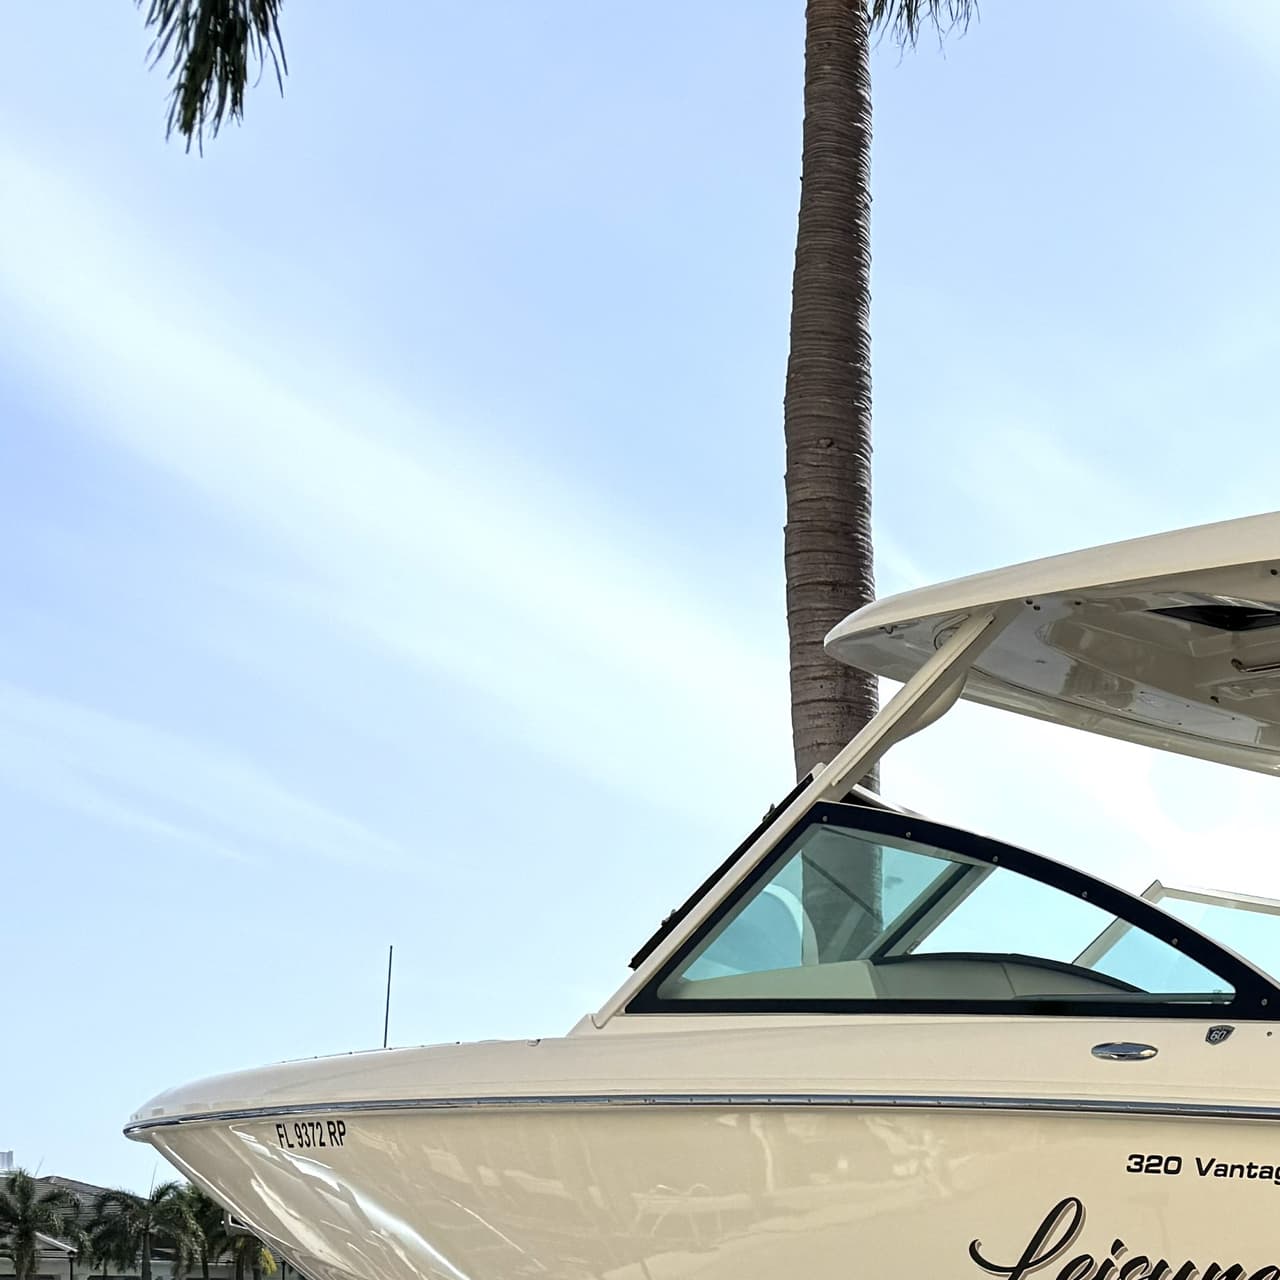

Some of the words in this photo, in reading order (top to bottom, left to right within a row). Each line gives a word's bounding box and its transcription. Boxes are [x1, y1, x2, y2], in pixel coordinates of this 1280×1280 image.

[275, 1122, 294, 1149] FL
[294, 1121, 326, 1148] 9372
[327, 1120, 347, 1147] RP
[1126, 1153, 1182, 1176] 320
